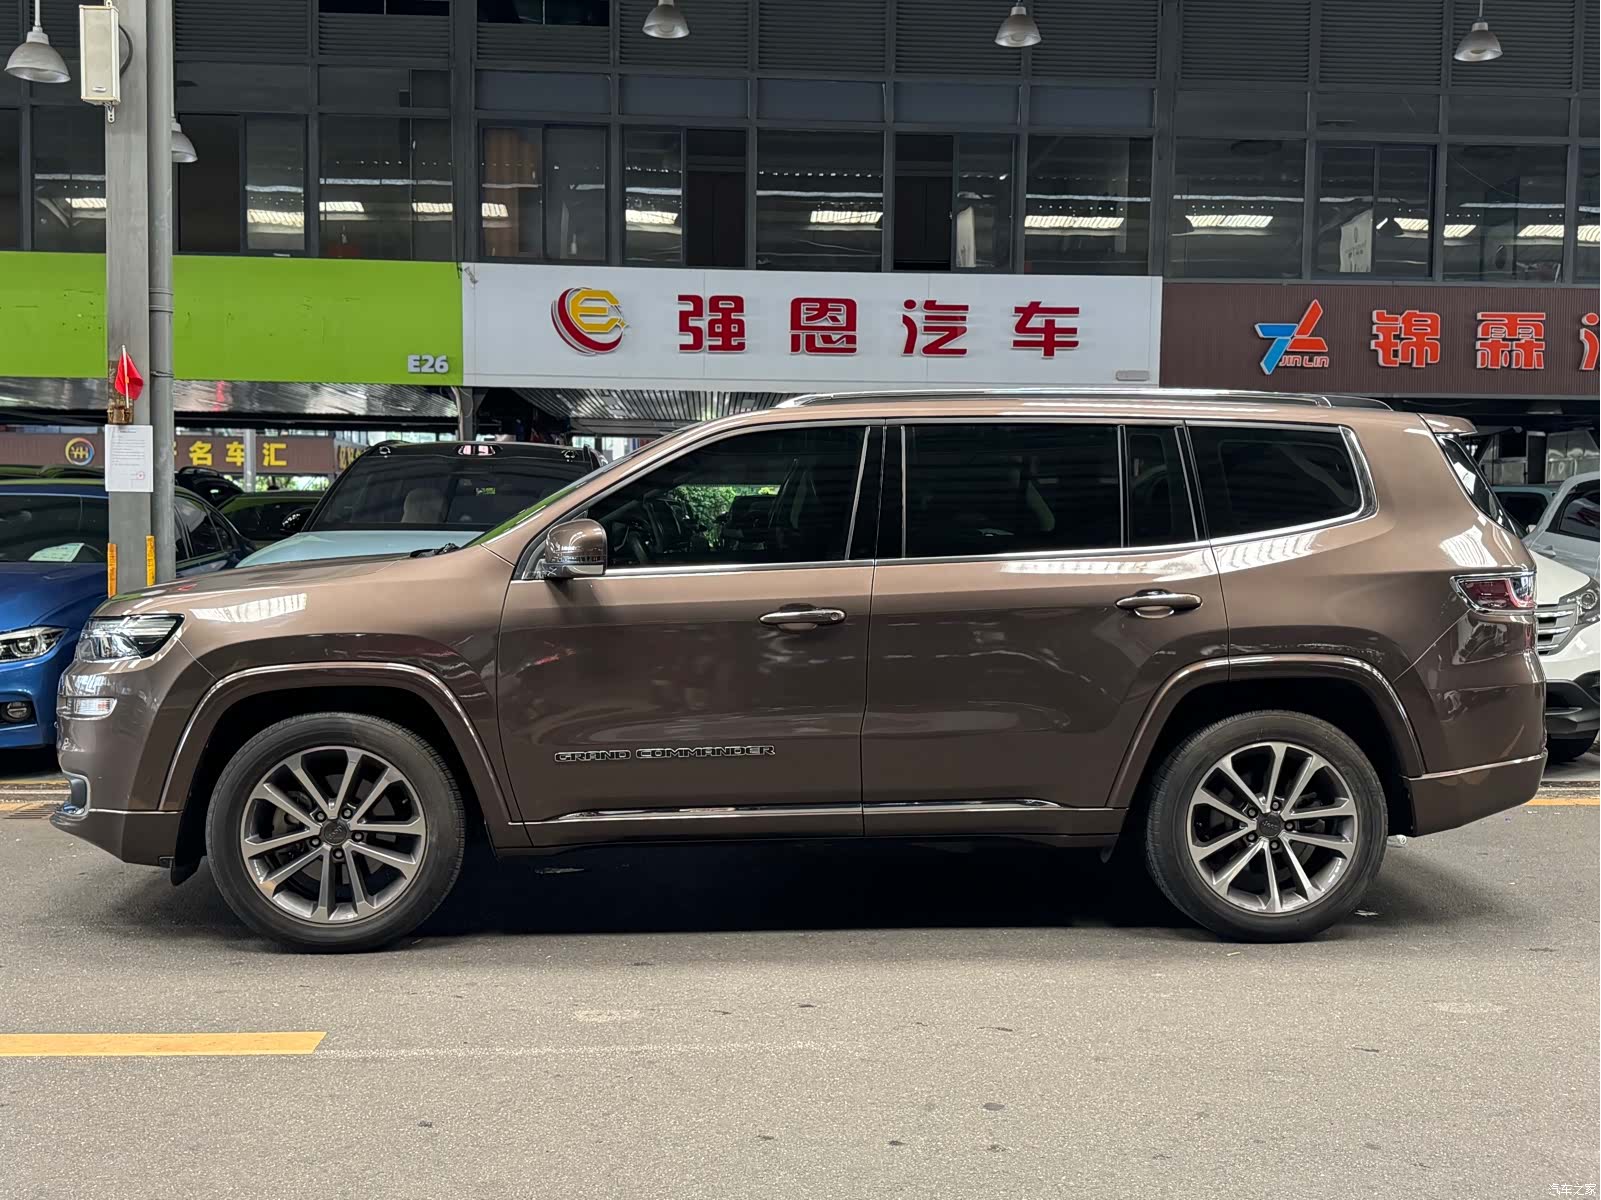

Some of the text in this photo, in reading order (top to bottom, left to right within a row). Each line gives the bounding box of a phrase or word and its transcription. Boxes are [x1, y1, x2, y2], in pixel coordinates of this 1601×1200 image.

[677, 294, 1081, 359] 强恩汽车
[407, 354, 449, 373] E26
[173, 440, 287, 467] 名车汇
[554, 745, 776, 763] GRAND COMMANDER
